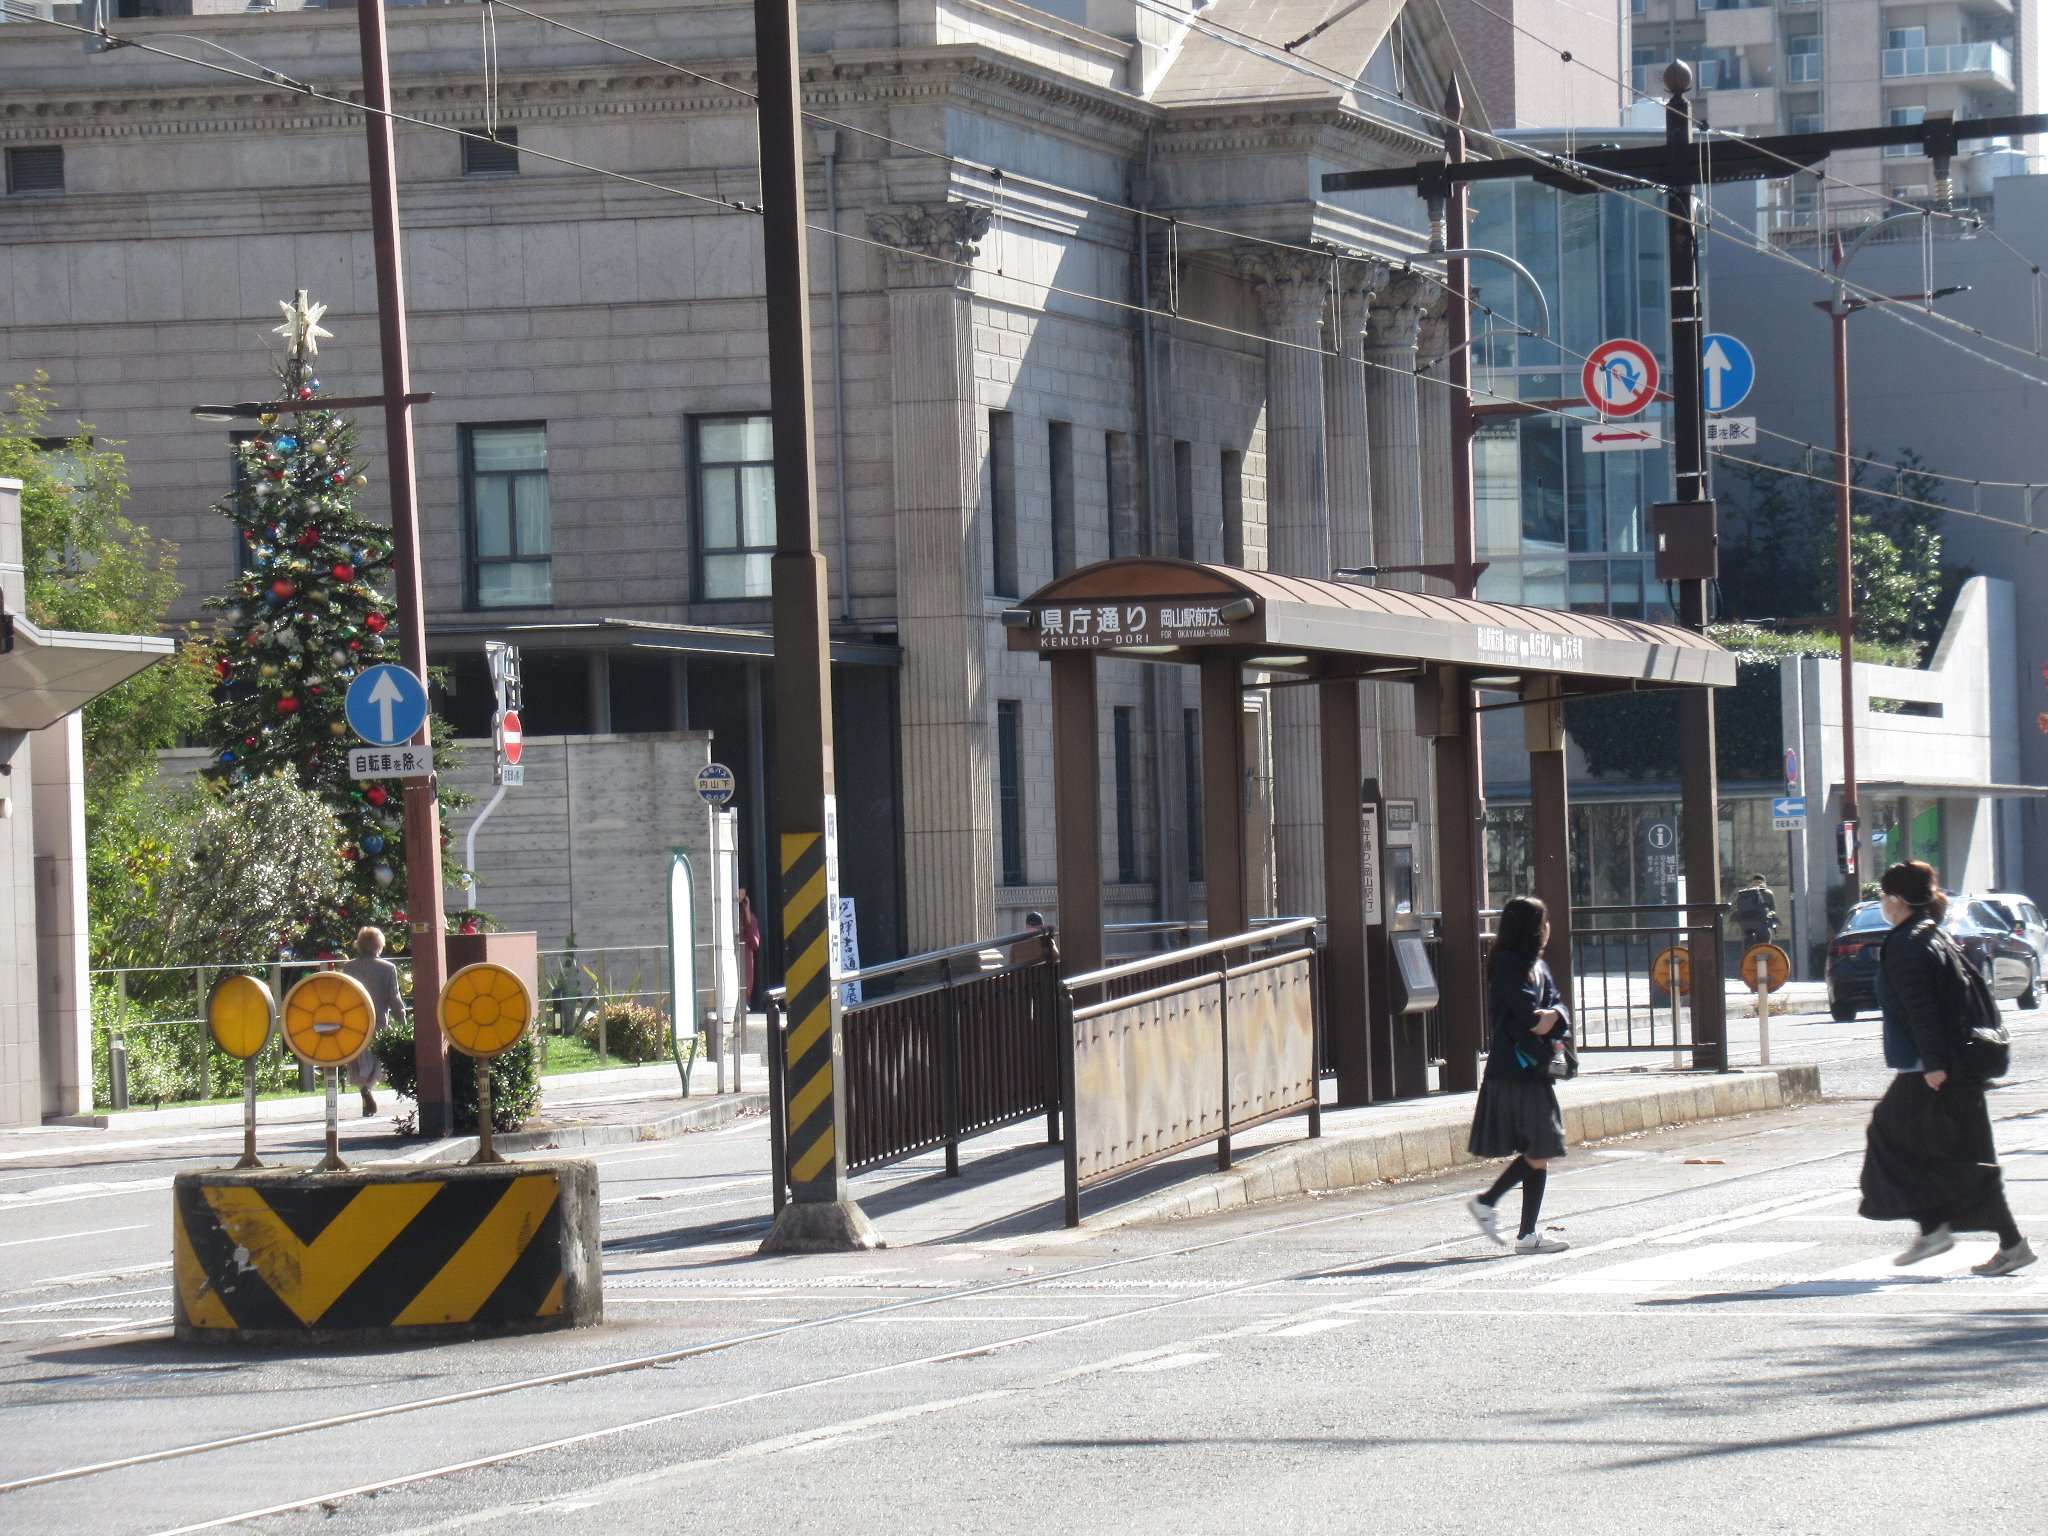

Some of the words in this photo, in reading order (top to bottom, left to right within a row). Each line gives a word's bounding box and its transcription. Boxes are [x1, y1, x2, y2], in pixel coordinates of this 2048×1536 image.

[1041, 606, 1147, 635] 県庁通り
[1160, 606, 1231, 629] 岡山駅前方
[1041, 634, 1149, 648] KENCHO-DORI
[1160, 630, 1172, 639] FOR
[356, 752, 425, 773] 自転車を除く
